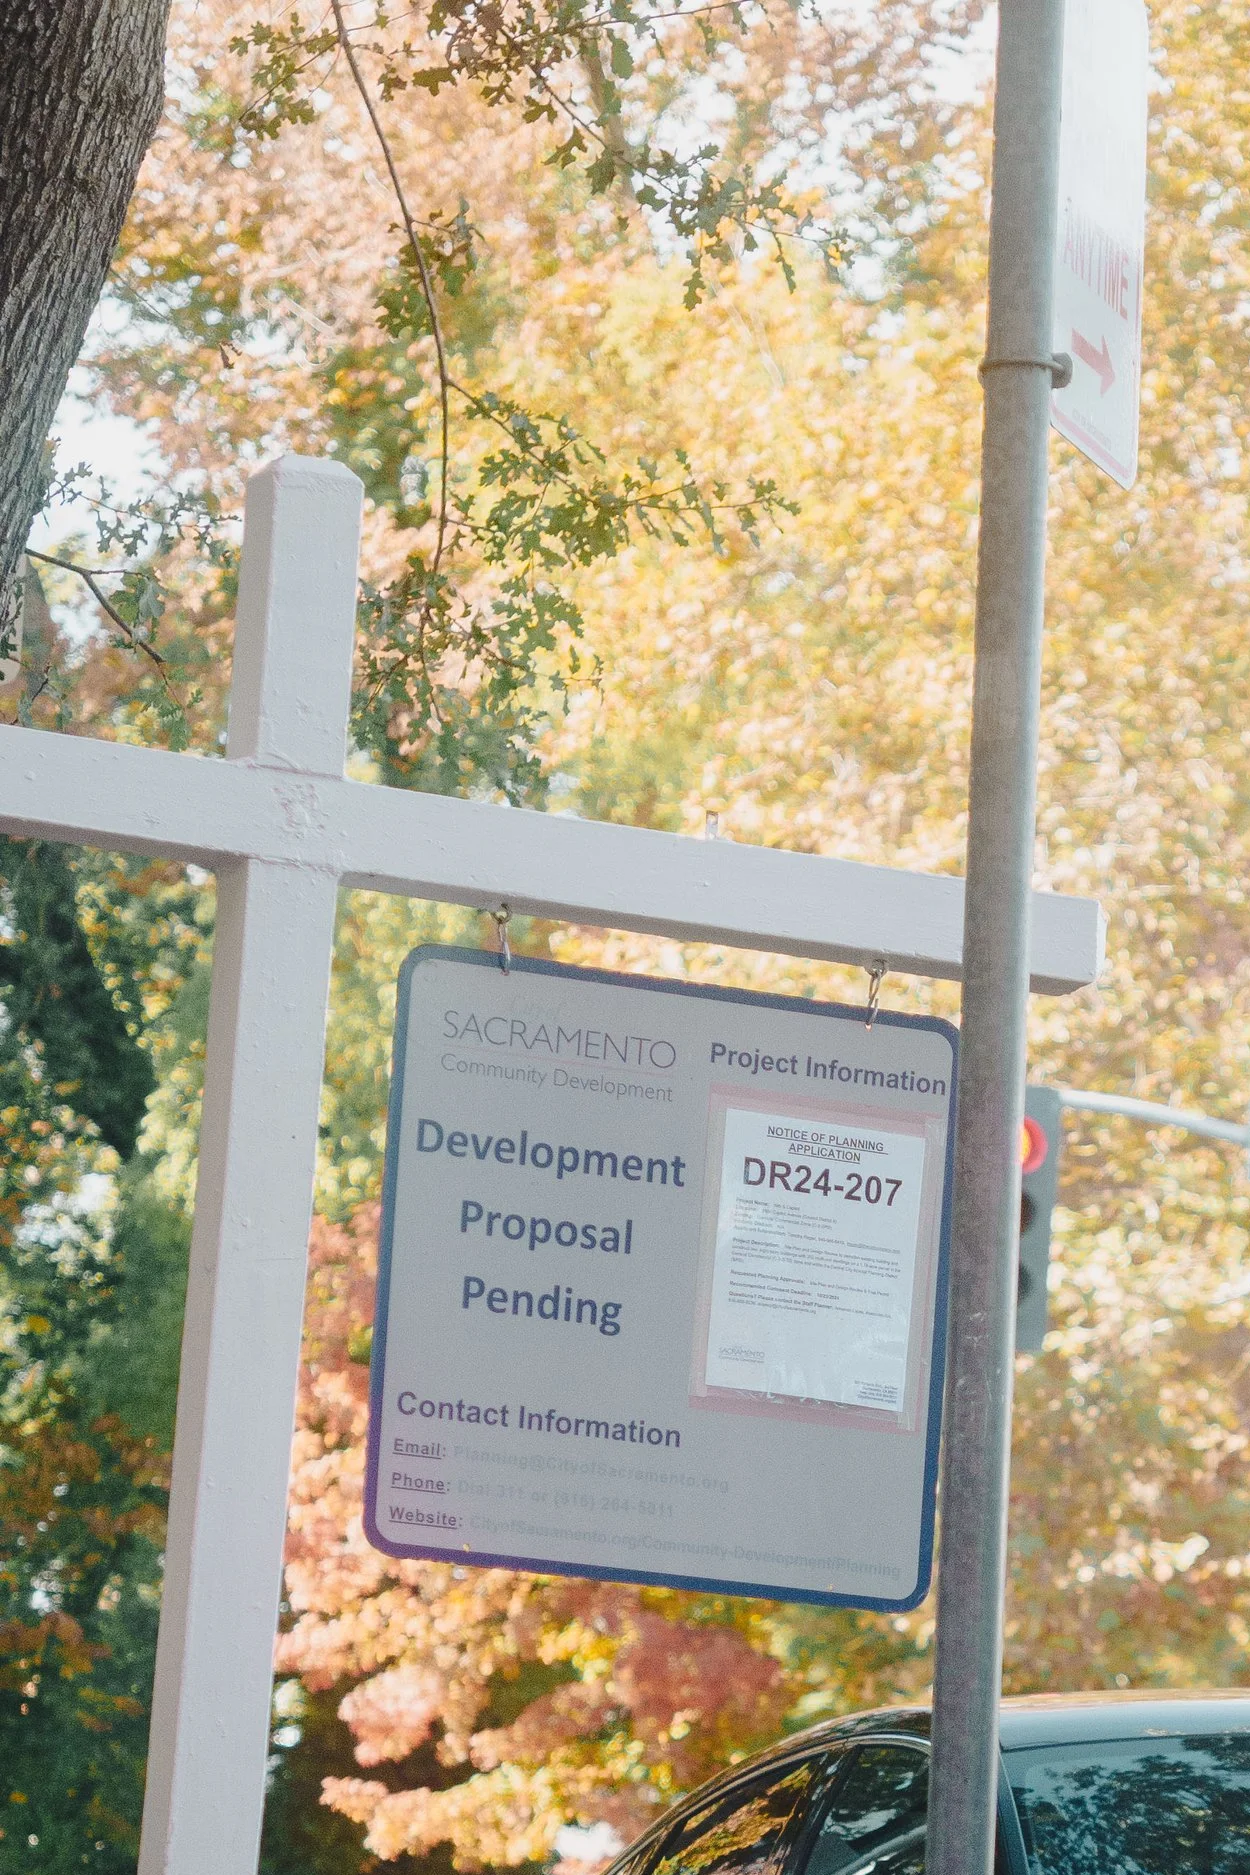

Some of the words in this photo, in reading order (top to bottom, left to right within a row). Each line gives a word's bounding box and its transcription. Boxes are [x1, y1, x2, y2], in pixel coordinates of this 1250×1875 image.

[1063, 218, 1129, 321] ANYTIME
[442, 1009, 677, 1069] SACRAMENTO
[440, 1053, 548, 1088] Community
[553, 1068, 673, 1102] Development
[710, 1042, 798, 1074] Project
[806, 1056, 947, 1096] Information
[416, 1118, 687, 1187] Development
[767, 1125, 808, 1141] NOTICE
[810, 1131, 826, 1142] OF
[828, 1135, 884, 1152] PLANNING
[788, 1143, 861, 1162] APPLICATION
[743, 1156, 903, 1206] DR24-207
[460, 1200, 633, 1254] Proposal
[462, 1276, 623, 1336] Pending
[397, 1390, 509, 1427] Contact
[518, 1405, 682, 1448] Information
[393, 1438, 446, 1459] Email:
[390, 1472, 451, 1494] Phone:
[389, 1506, 463, 1528] Website:
